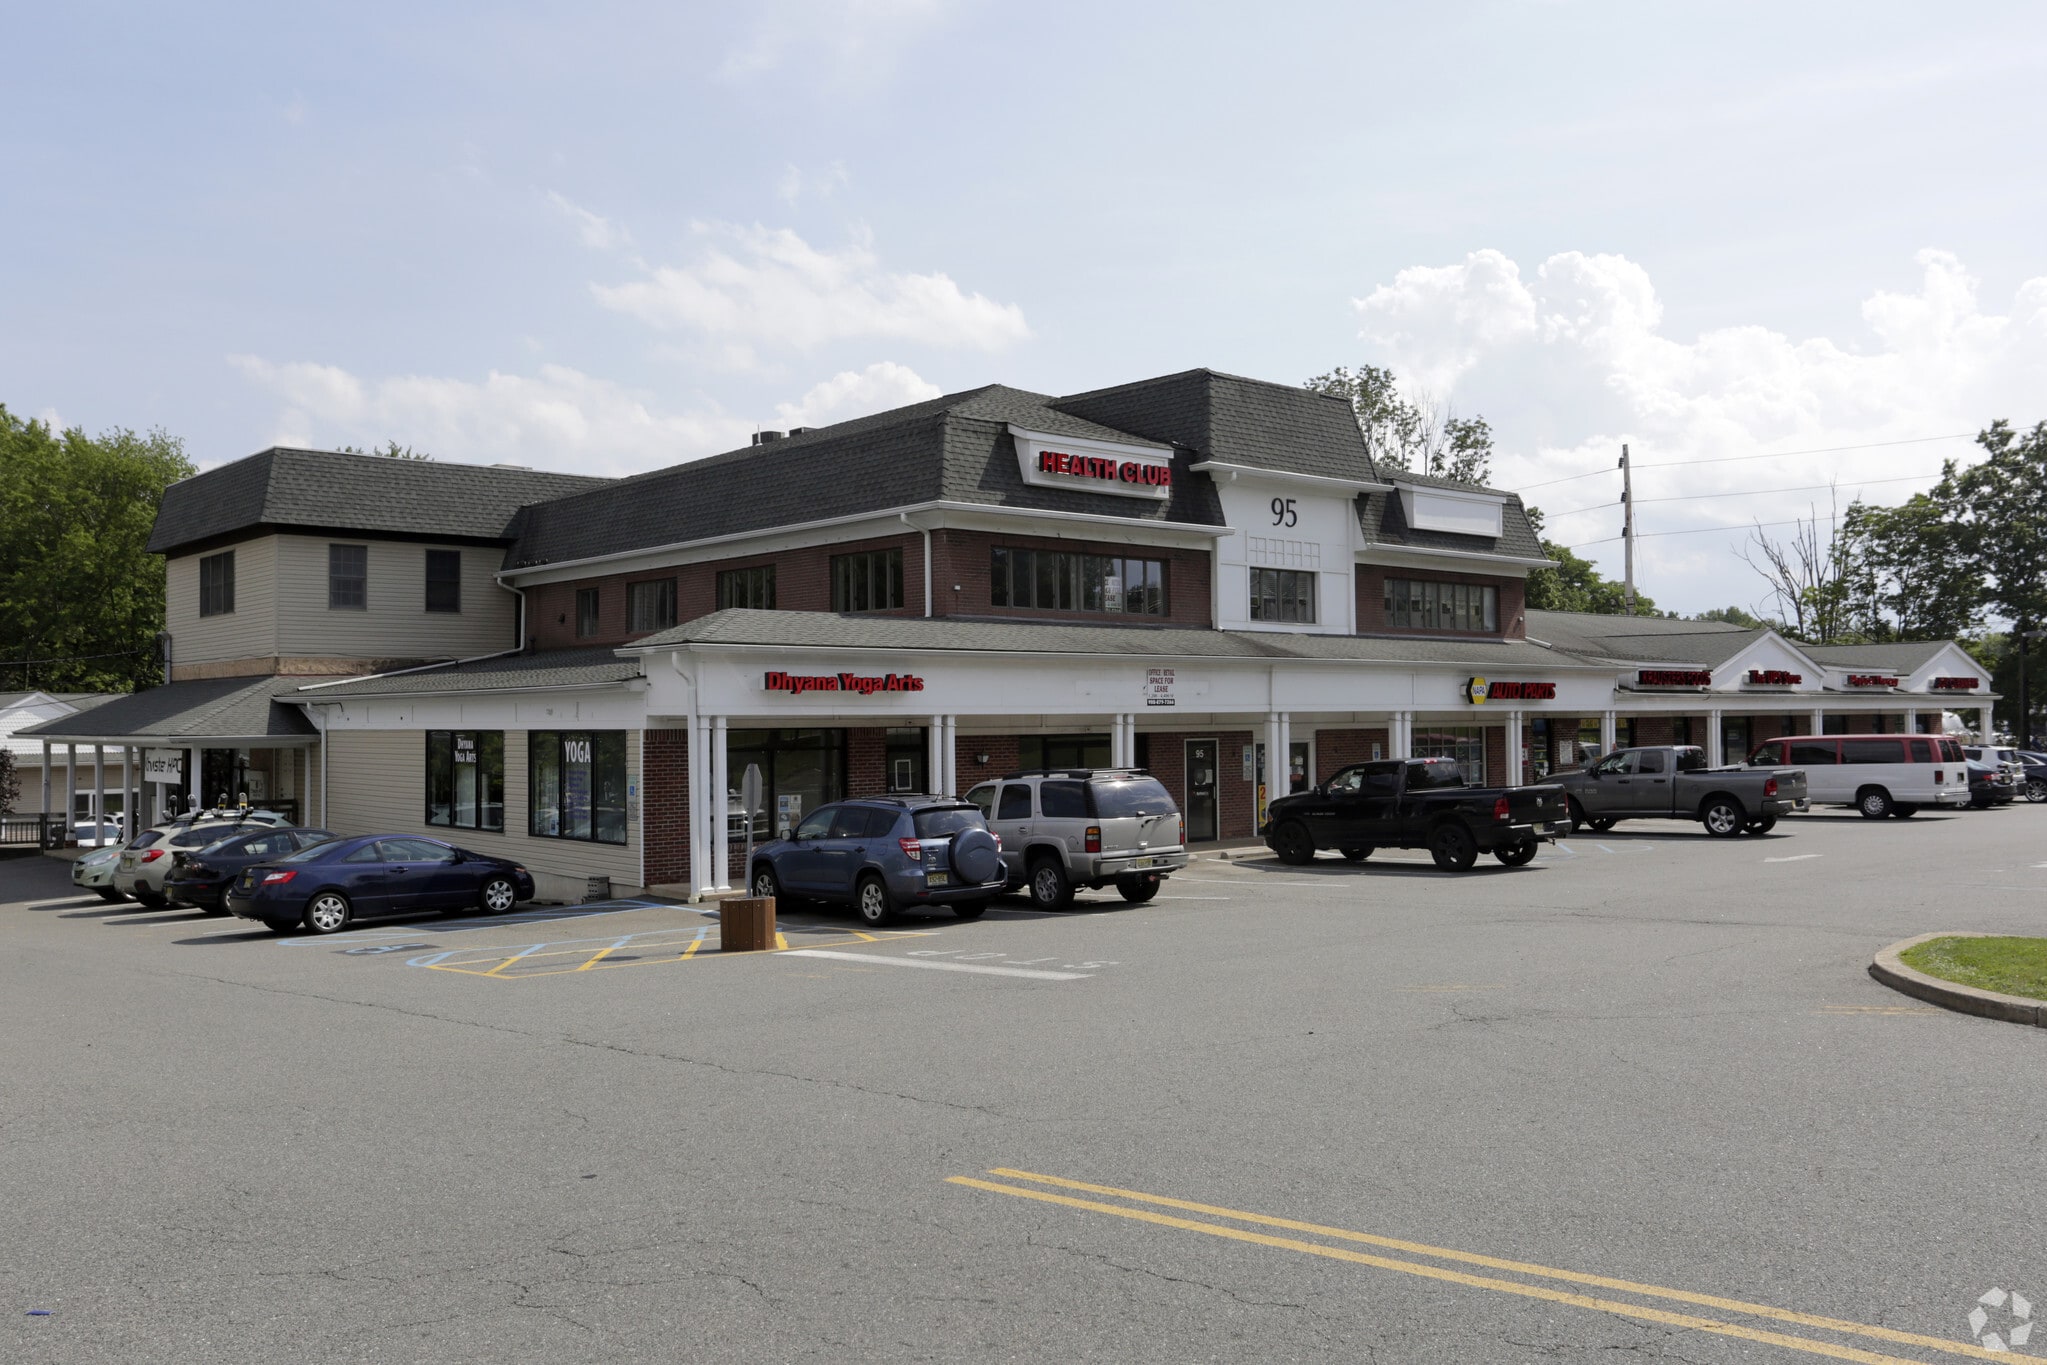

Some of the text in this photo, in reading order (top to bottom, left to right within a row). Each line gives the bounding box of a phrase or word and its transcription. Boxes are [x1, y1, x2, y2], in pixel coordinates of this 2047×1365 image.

[1040, 451, 1172, 486] HEALTH CLUB
[1271, 498, 1298, 527] 95
[765, 672, 924, 695] Dhyana Yoga Arts
[1473, 682, 1556, 699] NAPA AUTO PARTS
[565, 741, 591, 763] YOGA
[1195, 749, 1204, 758] 95
